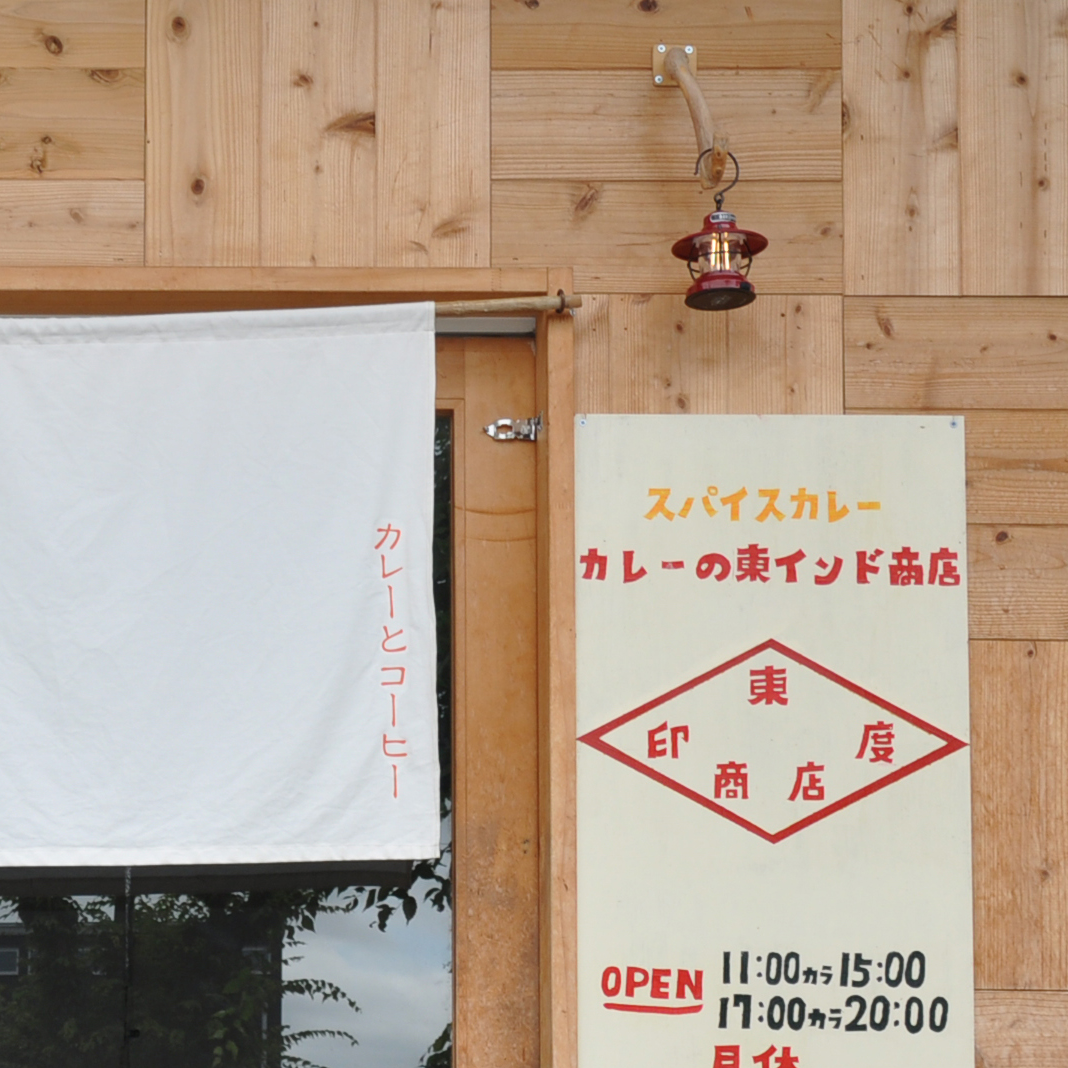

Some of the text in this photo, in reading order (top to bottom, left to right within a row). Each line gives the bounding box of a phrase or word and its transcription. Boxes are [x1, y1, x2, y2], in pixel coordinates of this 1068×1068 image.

[643, 485, 881, 523] スパイスカレー
[580, 543, 961, 587] カレーの東インド商店
[374, 523, 408, 799] カレーとコーヒー
[748, 665, 789, 706] 東
[647, 721, 896, 764] 印 度
[601, 965, 704, 1001] OPEN
